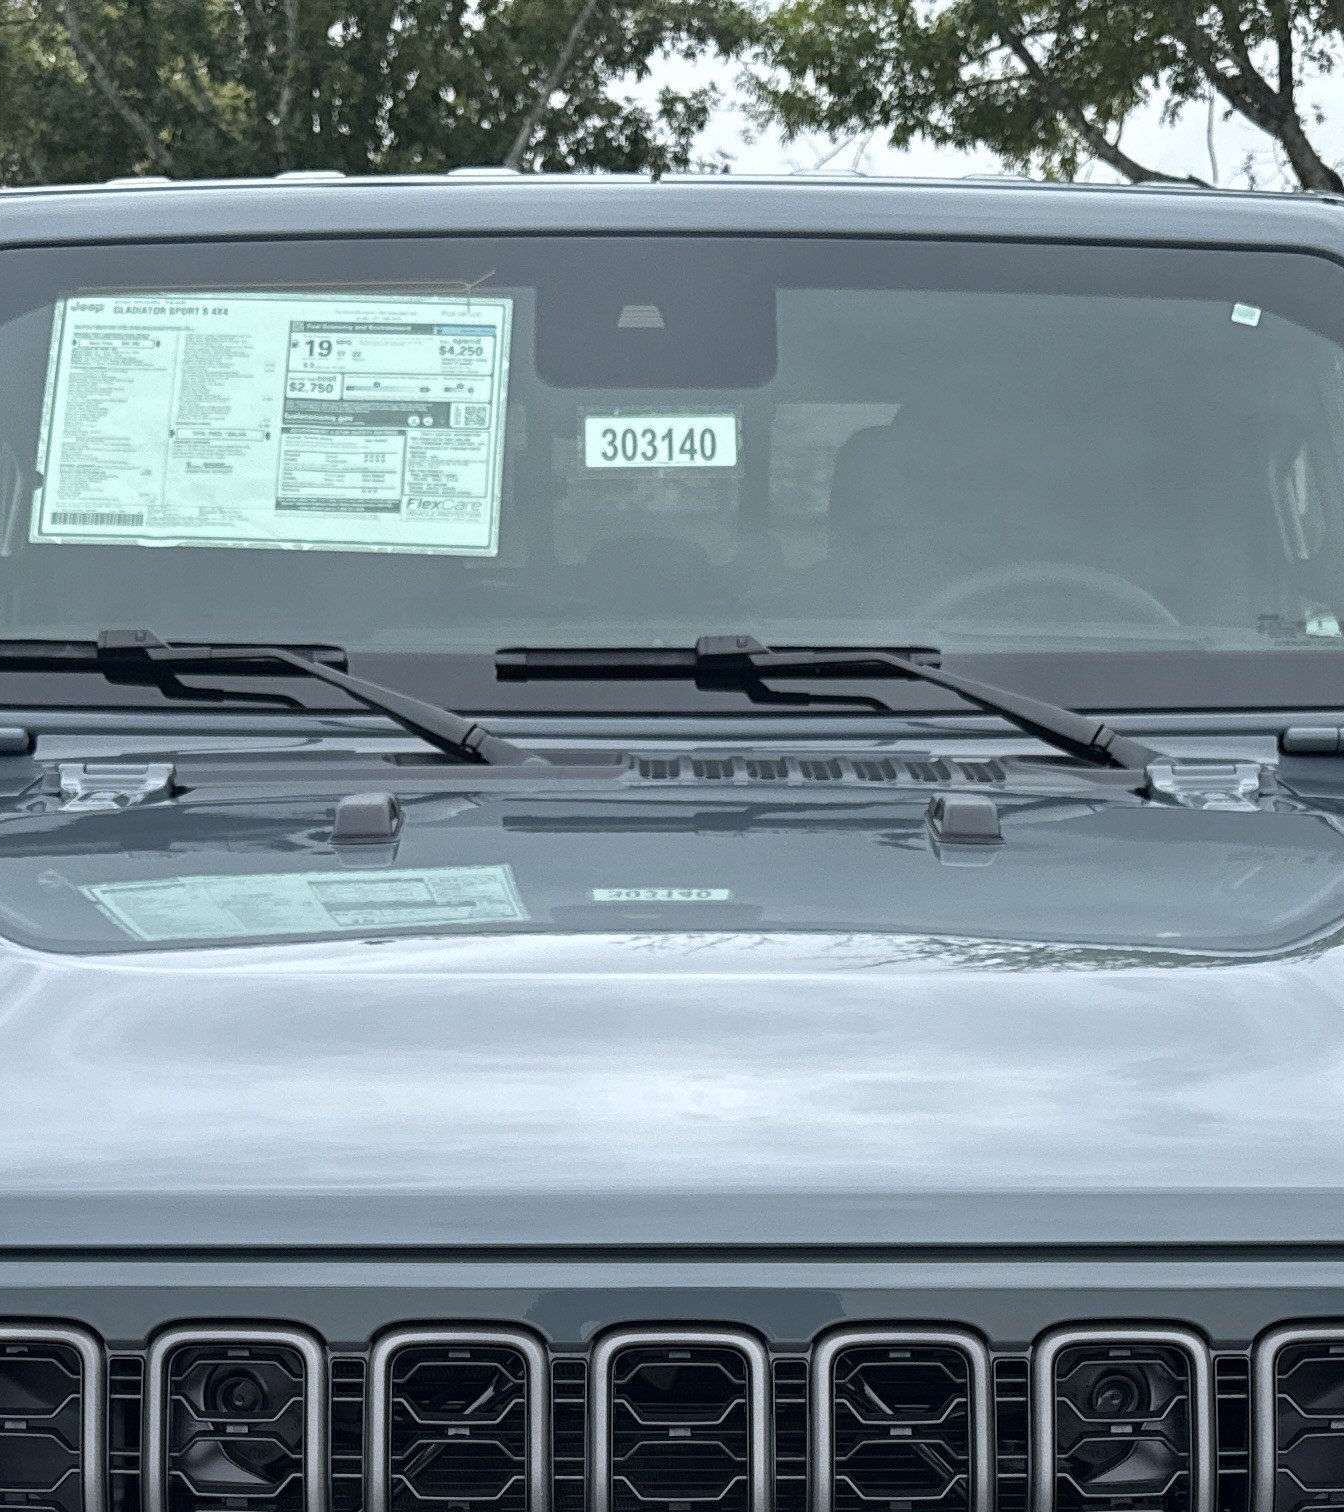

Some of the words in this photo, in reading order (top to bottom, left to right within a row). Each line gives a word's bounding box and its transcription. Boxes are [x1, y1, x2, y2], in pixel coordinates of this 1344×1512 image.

[70, 302, 104, 313] Jeep
[113, 305, 167, 315] GLADIATOR
[169, 306, 200, 315] SPORT
[306, 340, 333, 357] 19
[439, 345, 483, 356] $4,250
[289, 382, 334, 393] $2,750
[601, 428, 716, 461] 303140
[406, 498, 482, 510] FlexCare
